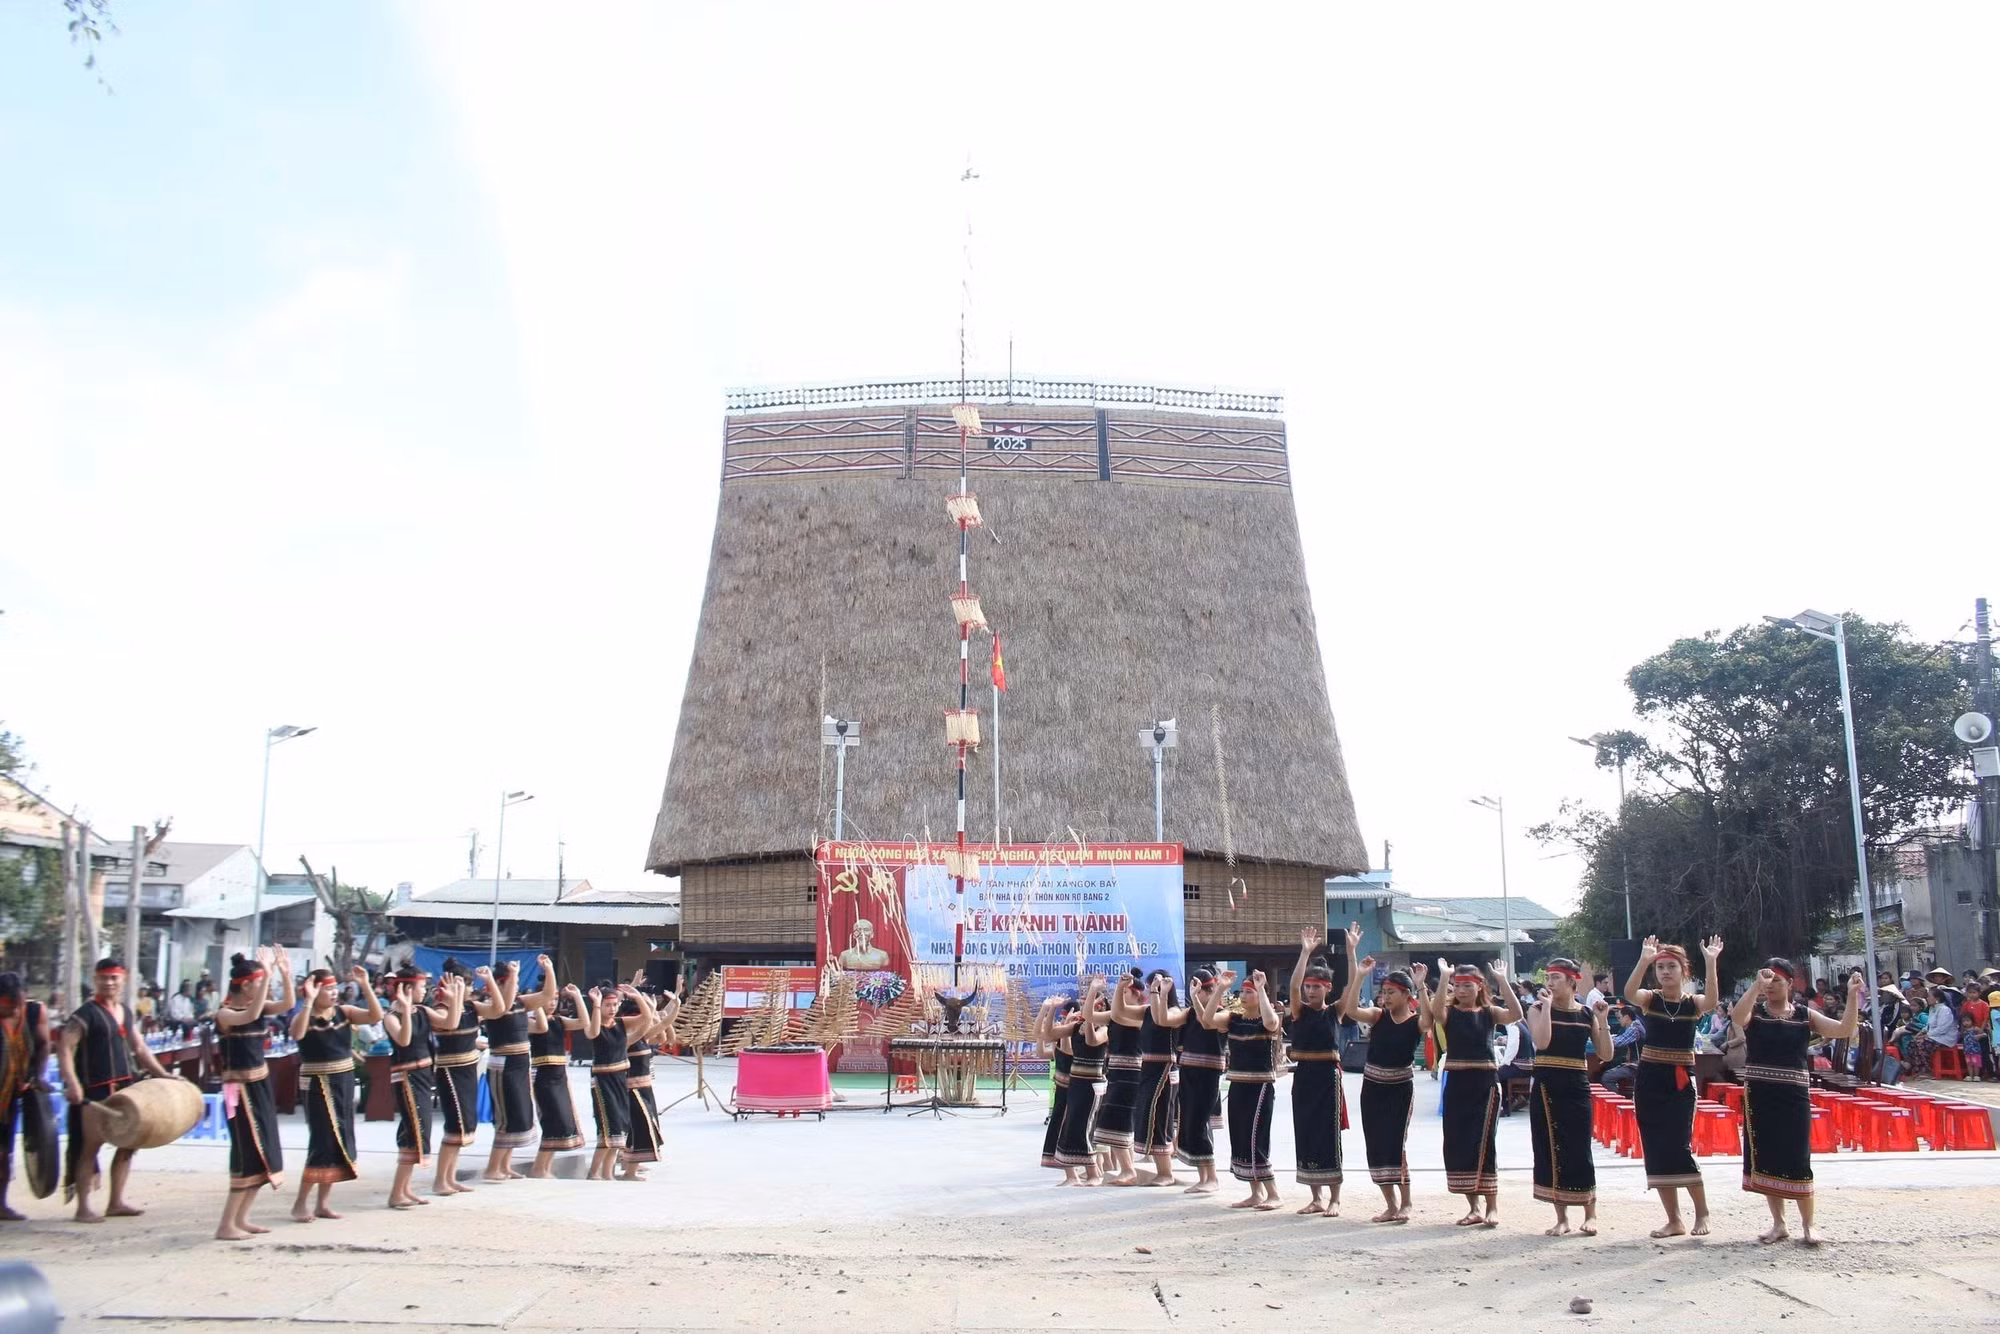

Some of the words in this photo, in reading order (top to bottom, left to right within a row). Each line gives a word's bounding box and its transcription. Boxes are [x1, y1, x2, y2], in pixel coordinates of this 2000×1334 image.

[993, 437, 1027, 450] 2025
[1097, 848, 1131, 860] MUÔN
[1135, 848, 1162, 860] NĂM
[1104, 892, 1110, 901] 2
[1042, 940, 1073, 955] THÔN
[1151, 942, 1158, 955] 2
[1009, 963, 1031, 976] BAY,
[1063, 963, 1100, 977] QUNG
